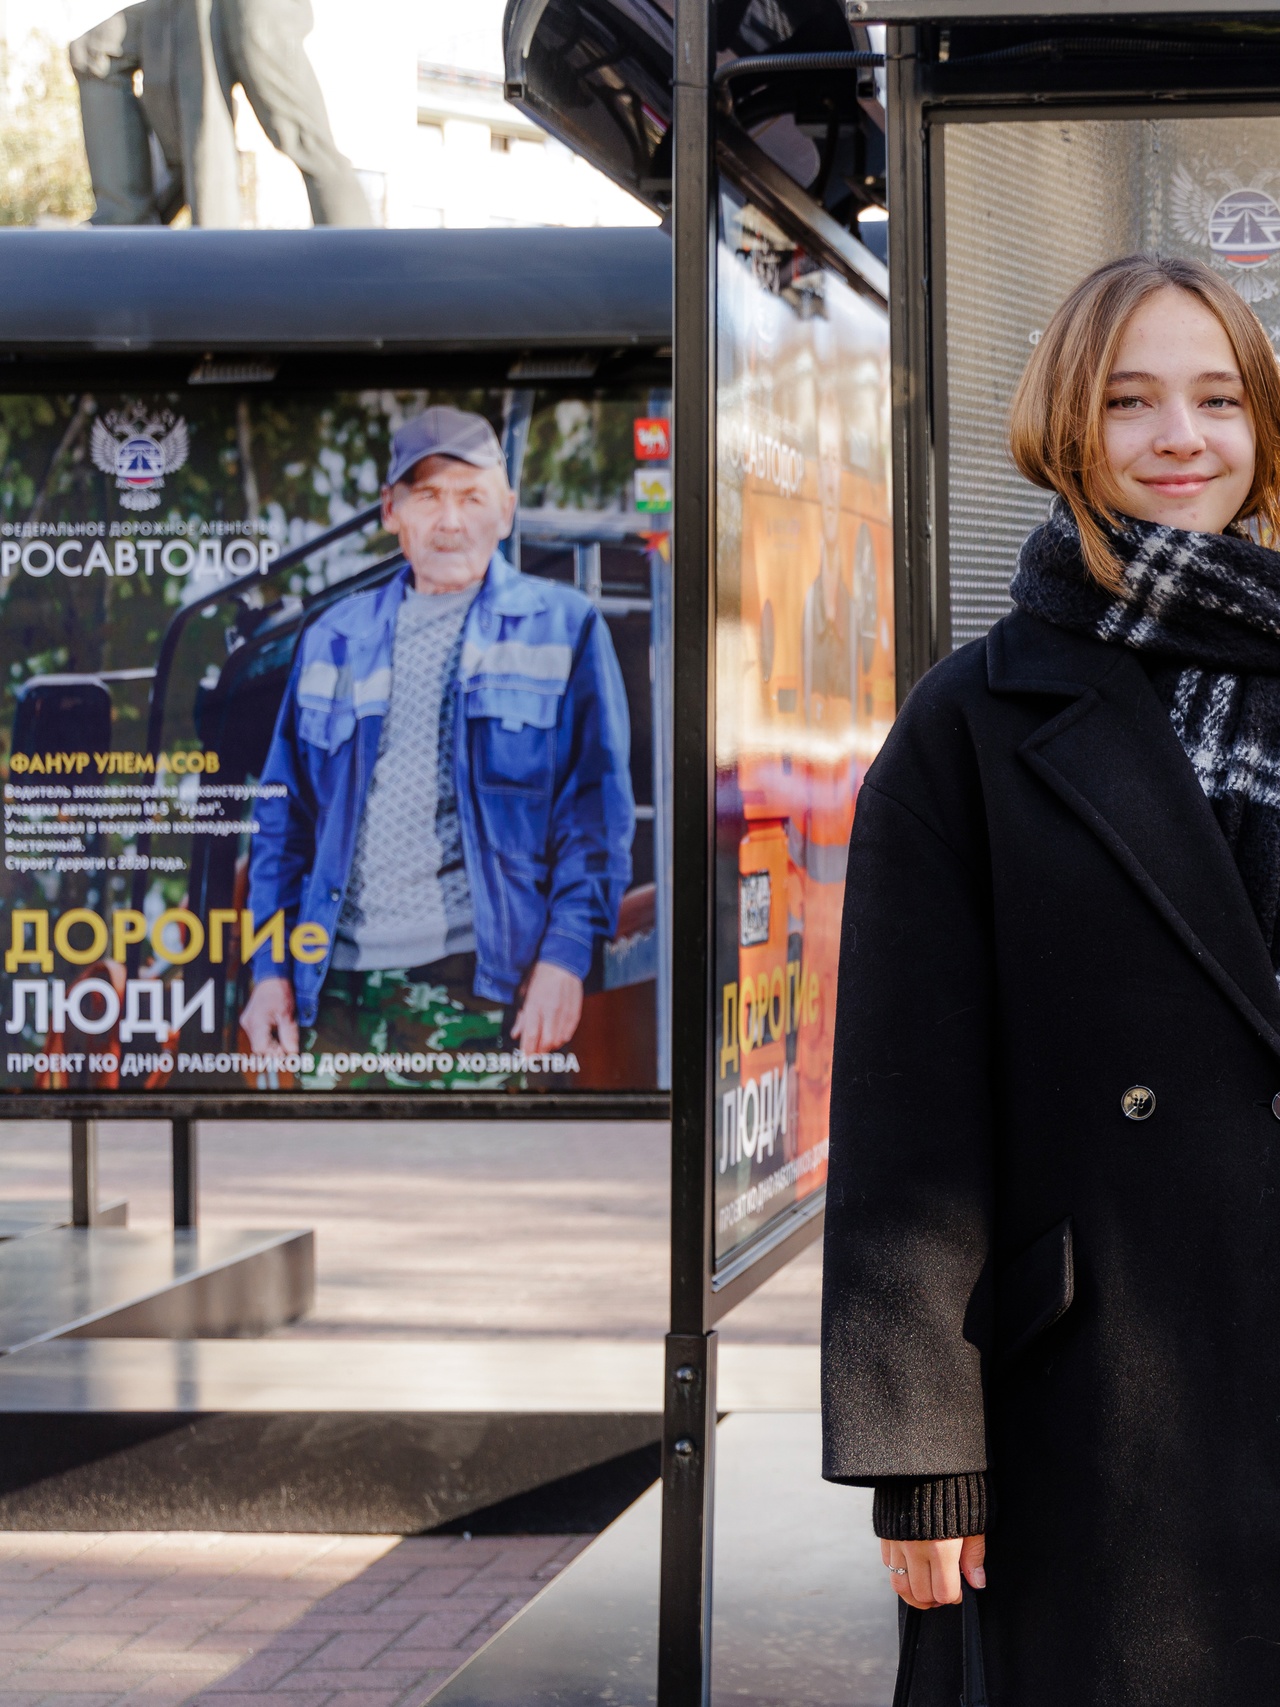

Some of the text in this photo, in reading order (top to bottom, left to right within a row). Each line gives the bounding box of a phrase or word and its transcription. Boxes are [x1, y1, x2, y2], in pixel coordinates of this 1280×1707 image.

[1, 538, 281, 582] РОСАВТОДОР
[10, 750, 221, 774] ФАНУР УЛЕМАСОВ
[5, 908, 330, 973] ДОРОГИе
[5, 977, 215, 1043] ЛЮДИ
[720, 960, 820, 1079] ДОРОГИе
[6, 1048, 580, 1077] ПРОЕКТ КО ДНЮ РАБОТНИКОВ ДОРОЖНОГО ХОЗЯЙСТВА
[719, 1062, 788, 1174] ЛЮДИ
